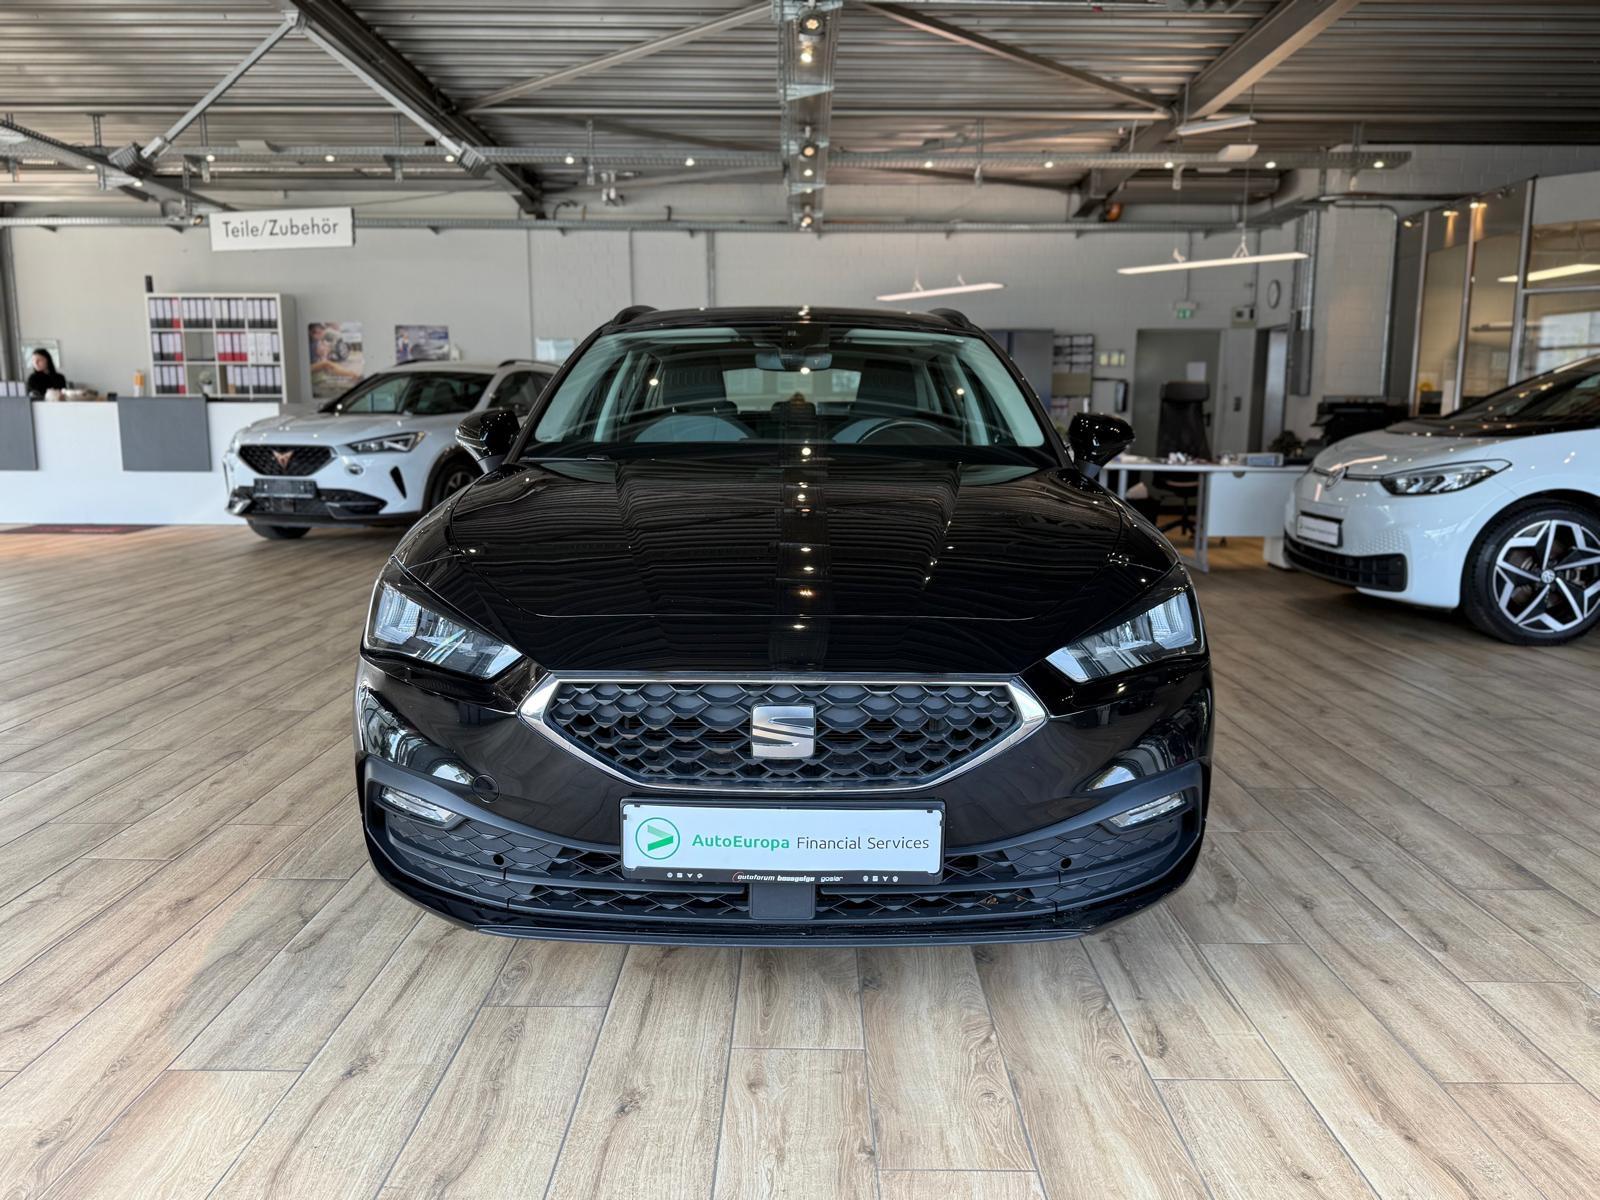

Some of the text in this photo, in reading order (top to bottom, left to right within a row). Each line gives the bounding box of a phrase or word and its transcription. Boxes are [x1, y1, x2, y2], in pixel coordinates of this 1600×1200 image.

[222, 216, 339, 238] Teile/Zubehör
[691, 834, 929, 851] AutoEuropa Financial Services
